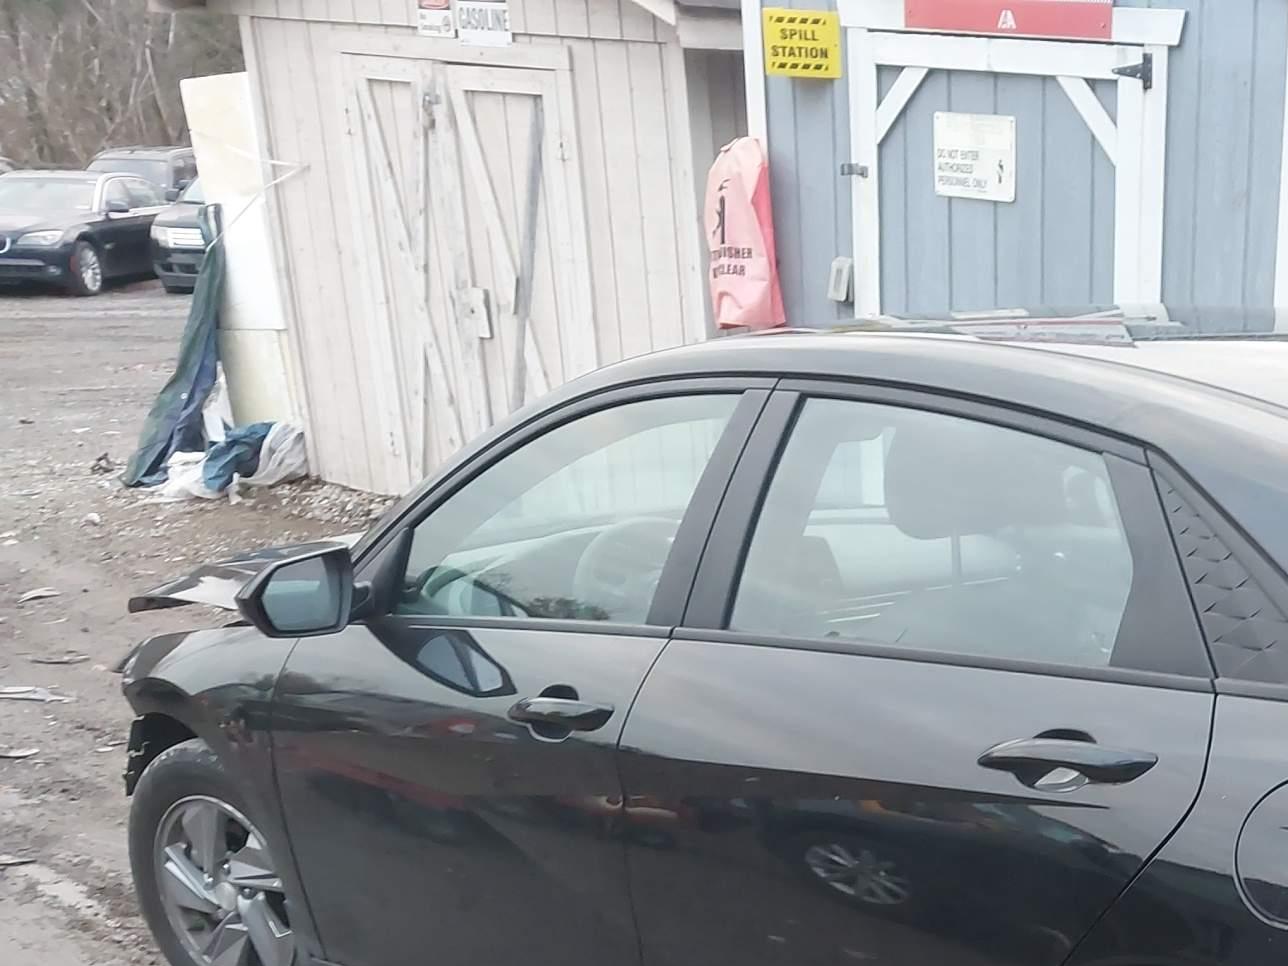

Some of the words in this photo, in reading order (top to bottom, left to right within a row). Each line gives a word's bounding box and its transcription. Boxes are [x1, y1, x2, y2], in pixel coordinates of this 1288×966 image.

[459, 7, 508, 31] GASOLINE
[779, 28, 820, 41] SPILL
[771, 45, 829, 58] STATION
